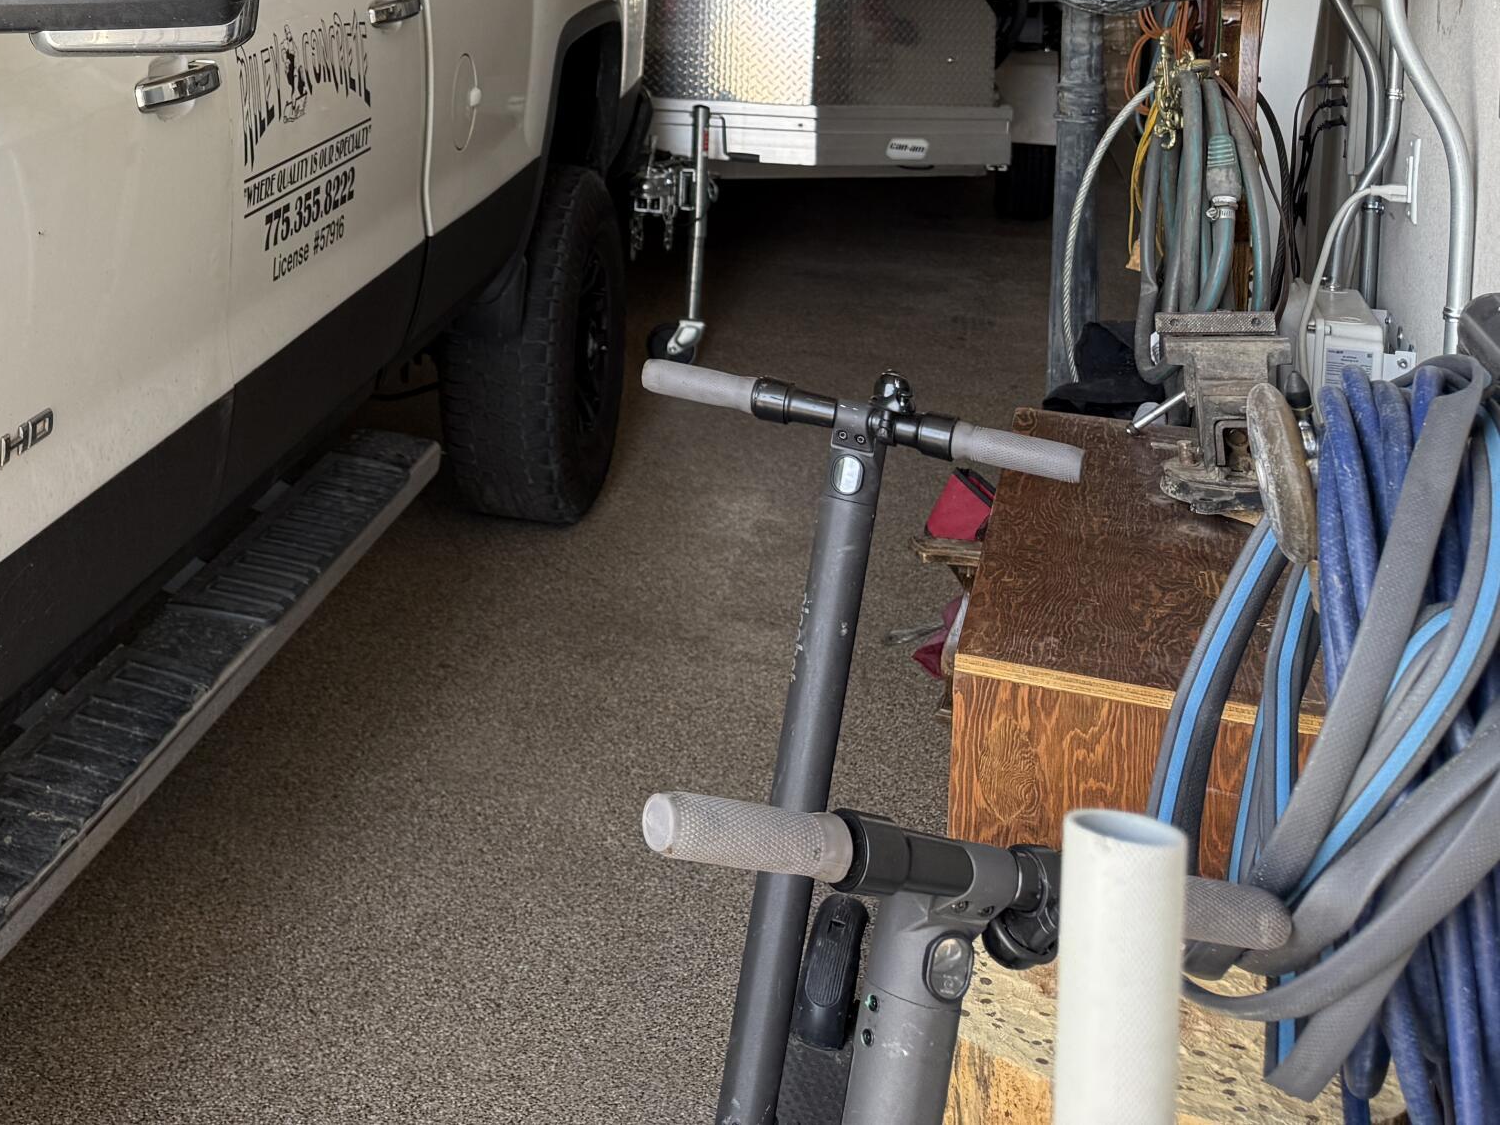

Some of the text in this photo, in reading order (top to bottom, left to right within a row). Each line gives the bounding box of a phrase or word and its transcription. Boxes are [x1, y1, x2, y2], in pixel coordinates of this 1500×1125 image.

[235, 8, 371, 172] RILEY CONCRETE
[277, 157, 308, 193] QUALITY
[310, 152, 318, 175] IS
[319, 144, 333, 170] OUR
[264, 166, 356, 251] 775.355.8222
[272, 214, 345, 282] License #57916
[0, 406, 54, 468] HD
